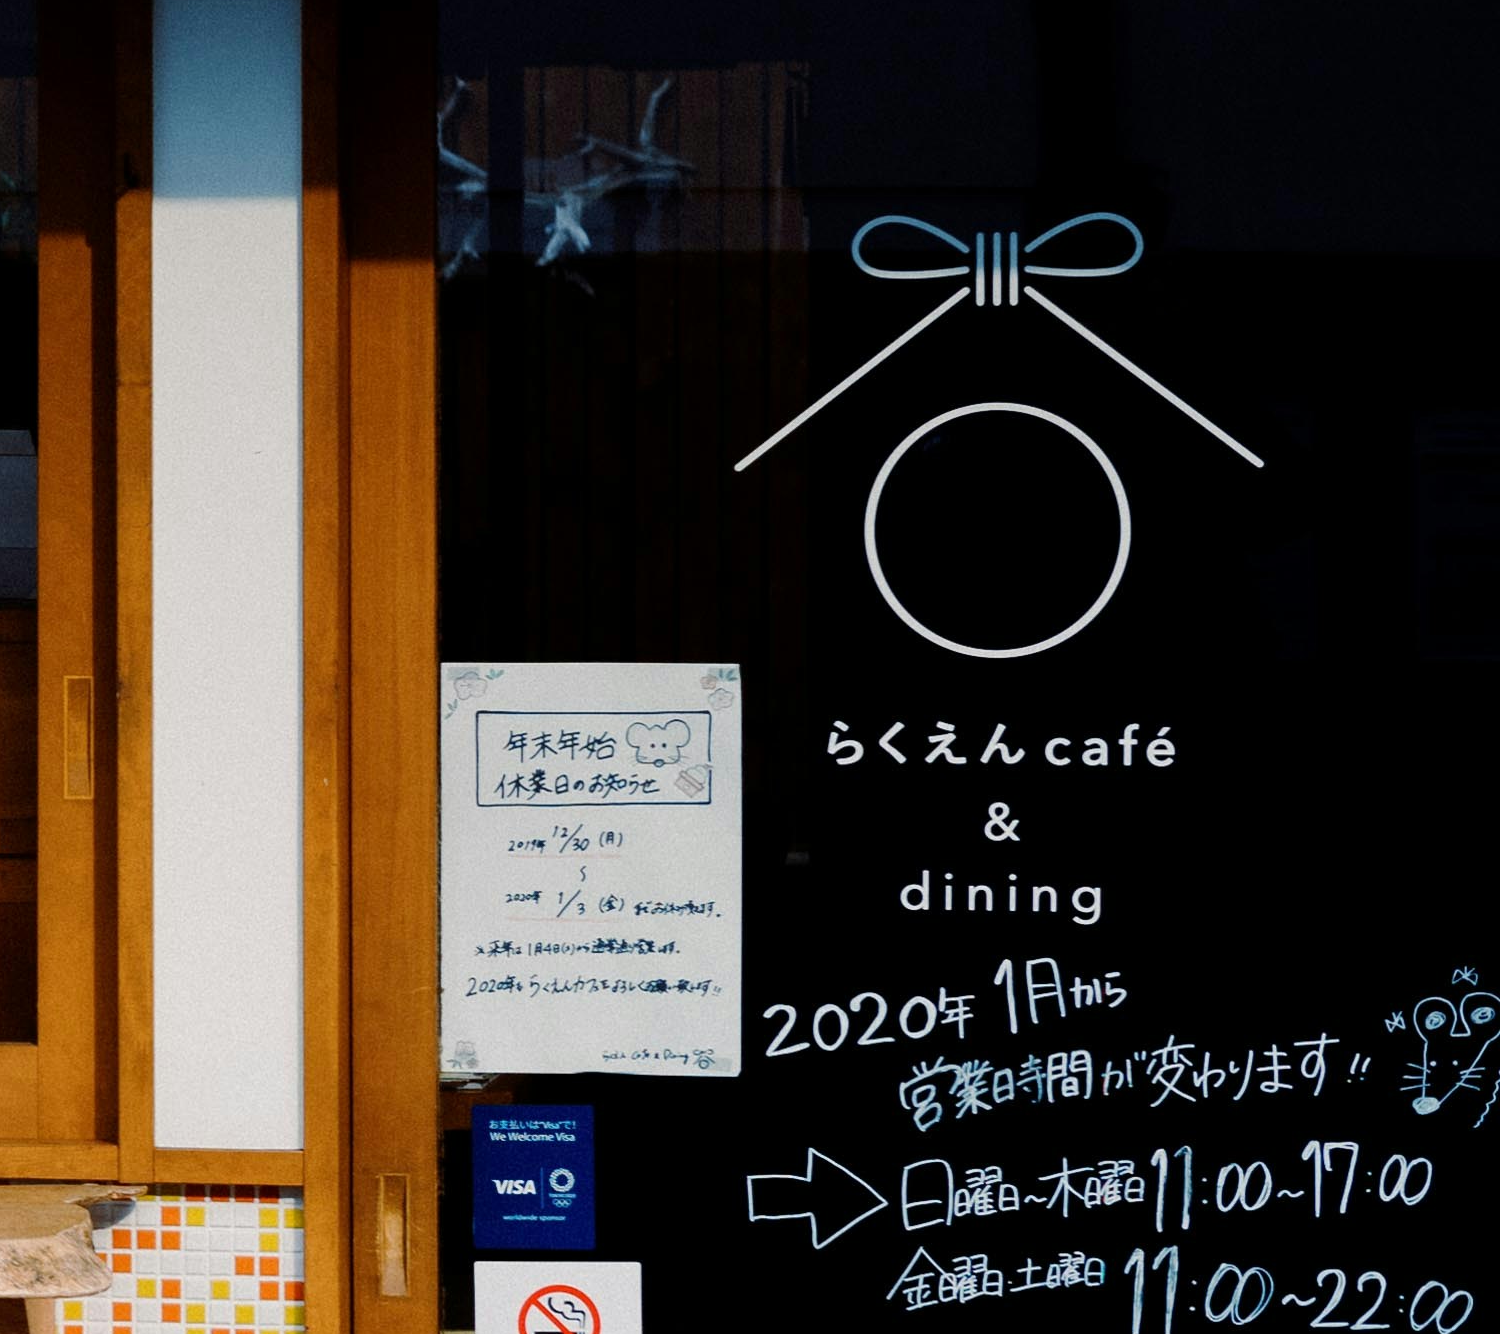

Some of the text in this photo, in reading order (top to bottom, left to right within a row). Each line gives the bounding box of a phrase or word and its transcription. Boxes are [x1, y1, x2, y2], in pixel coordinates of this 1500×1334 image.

[502, 730, 617, 763] 年末年始
[827, 720, 1177, 767] らくえん café
[493, 769, 660, 801] 休業日のお知らせ
[984, 802, 1021, 841] &
[552, 823, 590, 854] 12/30
[599, 831, 624, 848] (月)
[556, 889, 586, 918] 1/3
[900, 870, 1102, 925] dining
[490, 1132, 576, 1142] We Welcome Visa
[492, 1179, 537, 1195] VISA
